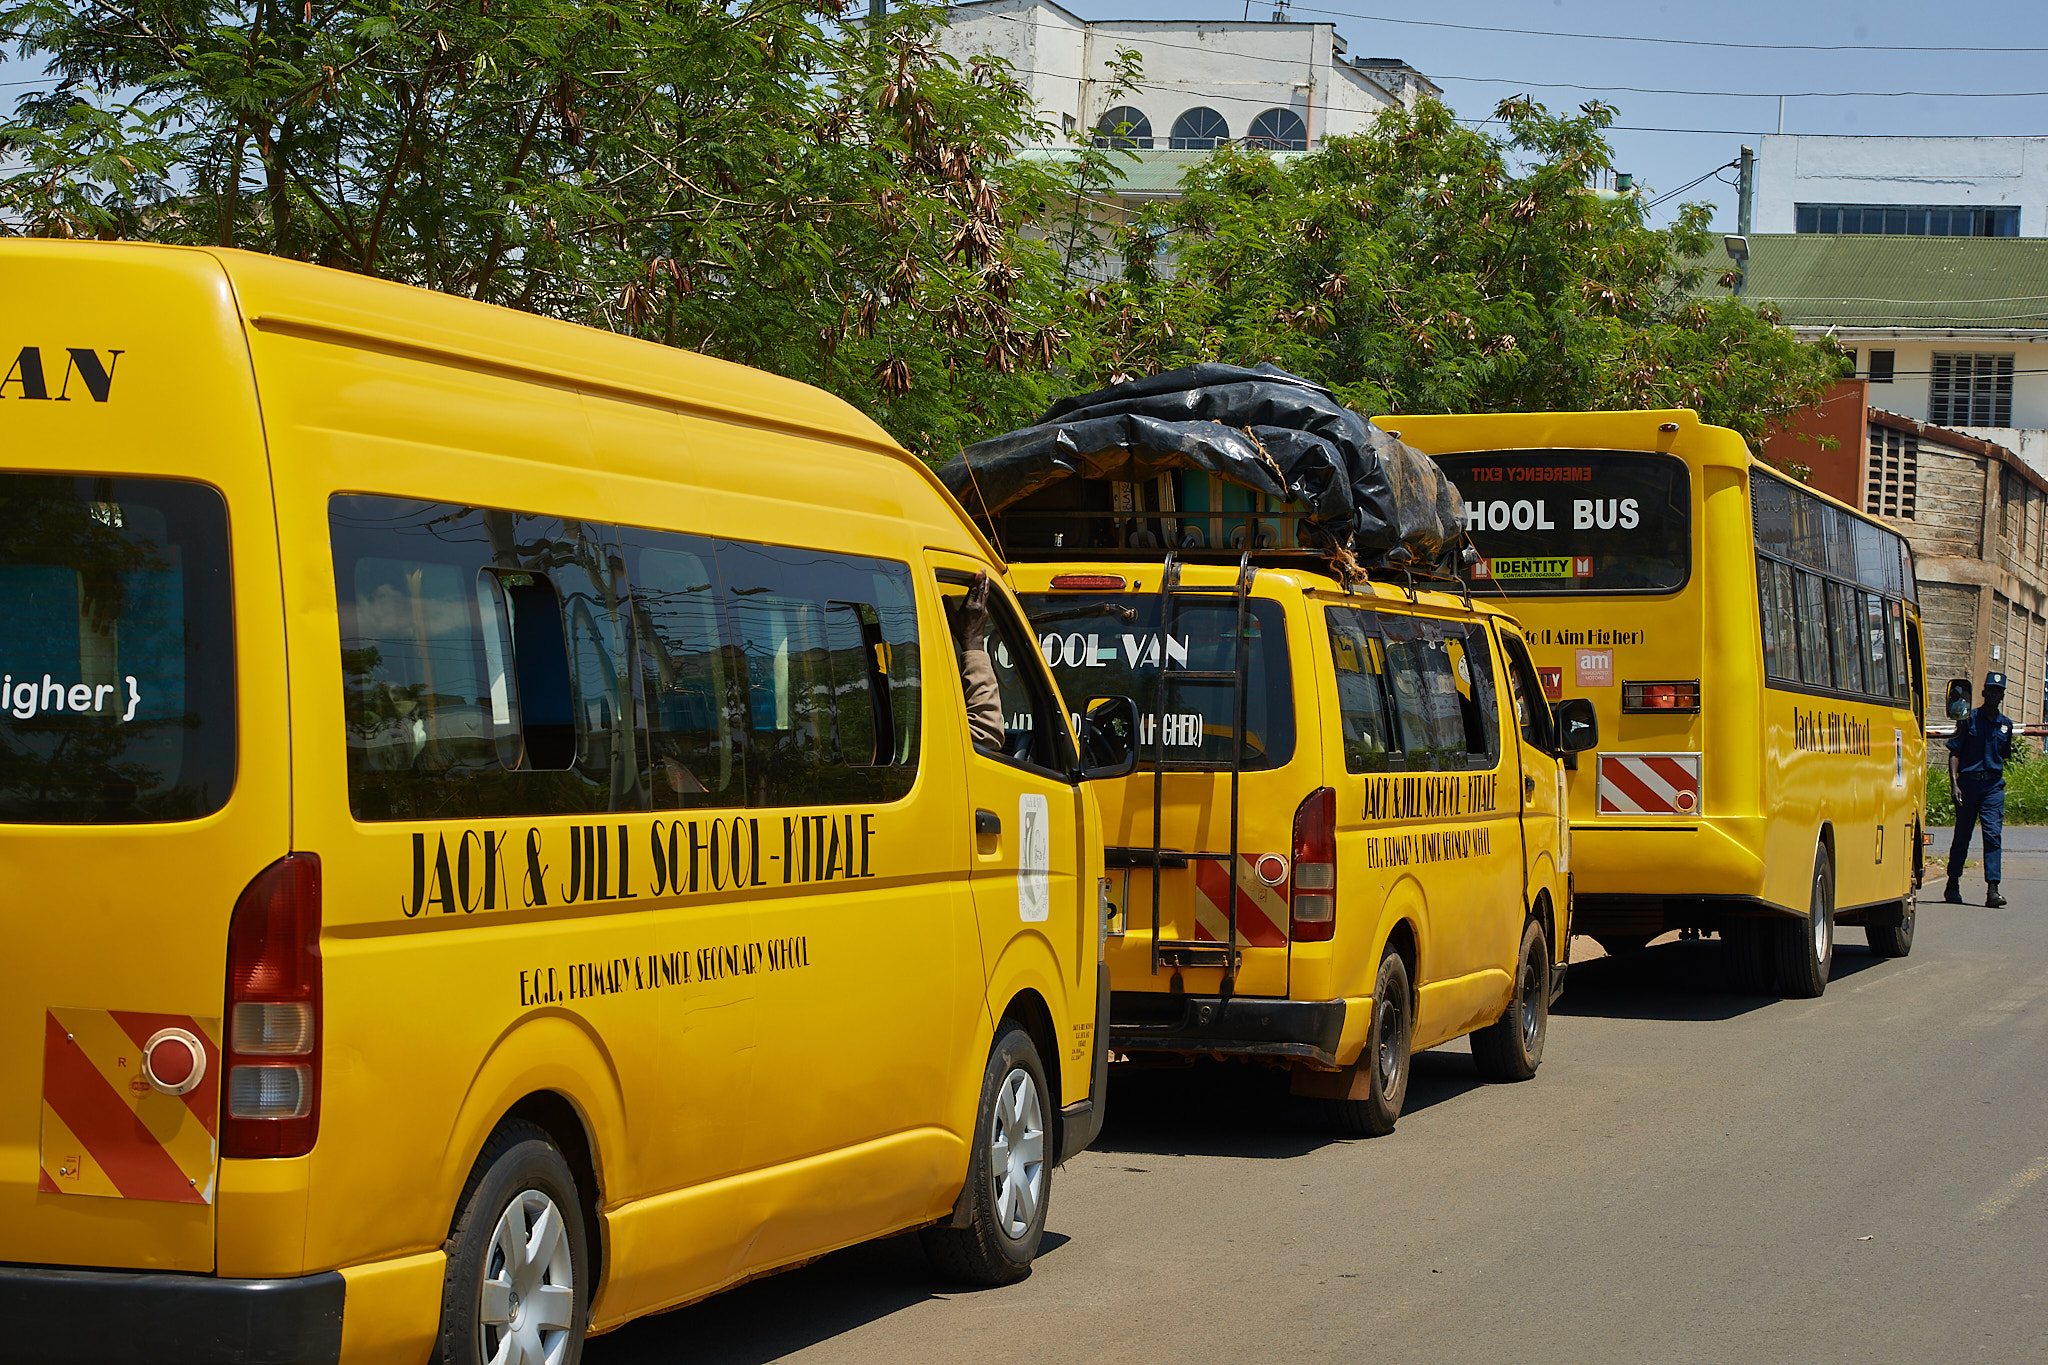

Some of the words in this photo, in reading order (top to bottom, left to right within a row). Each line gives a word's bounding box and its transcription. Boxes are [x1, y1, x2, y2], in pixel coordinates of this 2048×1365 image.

[0, 346, 125, 402] AN
[1464, 499, 1555, 531] HOOL
[1573, 498, 1640, 530] BUS
[1495, 560, 1569, 573] IDENTITY
[1525, 630, 1539, 645] to
[1554, 629, 1584, 645] Aim
[1540, 673, 1560, 687] ITY
[1580, 655, 1609, 670] am
[1, 673, 114, 719] igher
[1793, 706, 1816, 752] Jack
[1818, 711, 1825, 753] &
[1827, 711, 1841, 755] Jill
[1843, 712, 1871, 756] School
[1362, 777, 1391, 820] JACK
[1393, 777, 1401, 819] &
[1401, 777, 1422, 819] JILL
[1425, 776, 1461, 818] SCHOOL
[401, 829, 509, 918] JACK
[522, 826, 549, 906] &
[561, 825, 638, 904] JILL
[568, 958, 633, 1000] PRIMARY
[634, 956, 644, 990] &
[646, 951, 693, 990] JUNIOR
[696, 942, 765, 983] SECONDARY
[767, 936, 810, 972] SCHOOL
[117, 1057, 127, 1068] R
